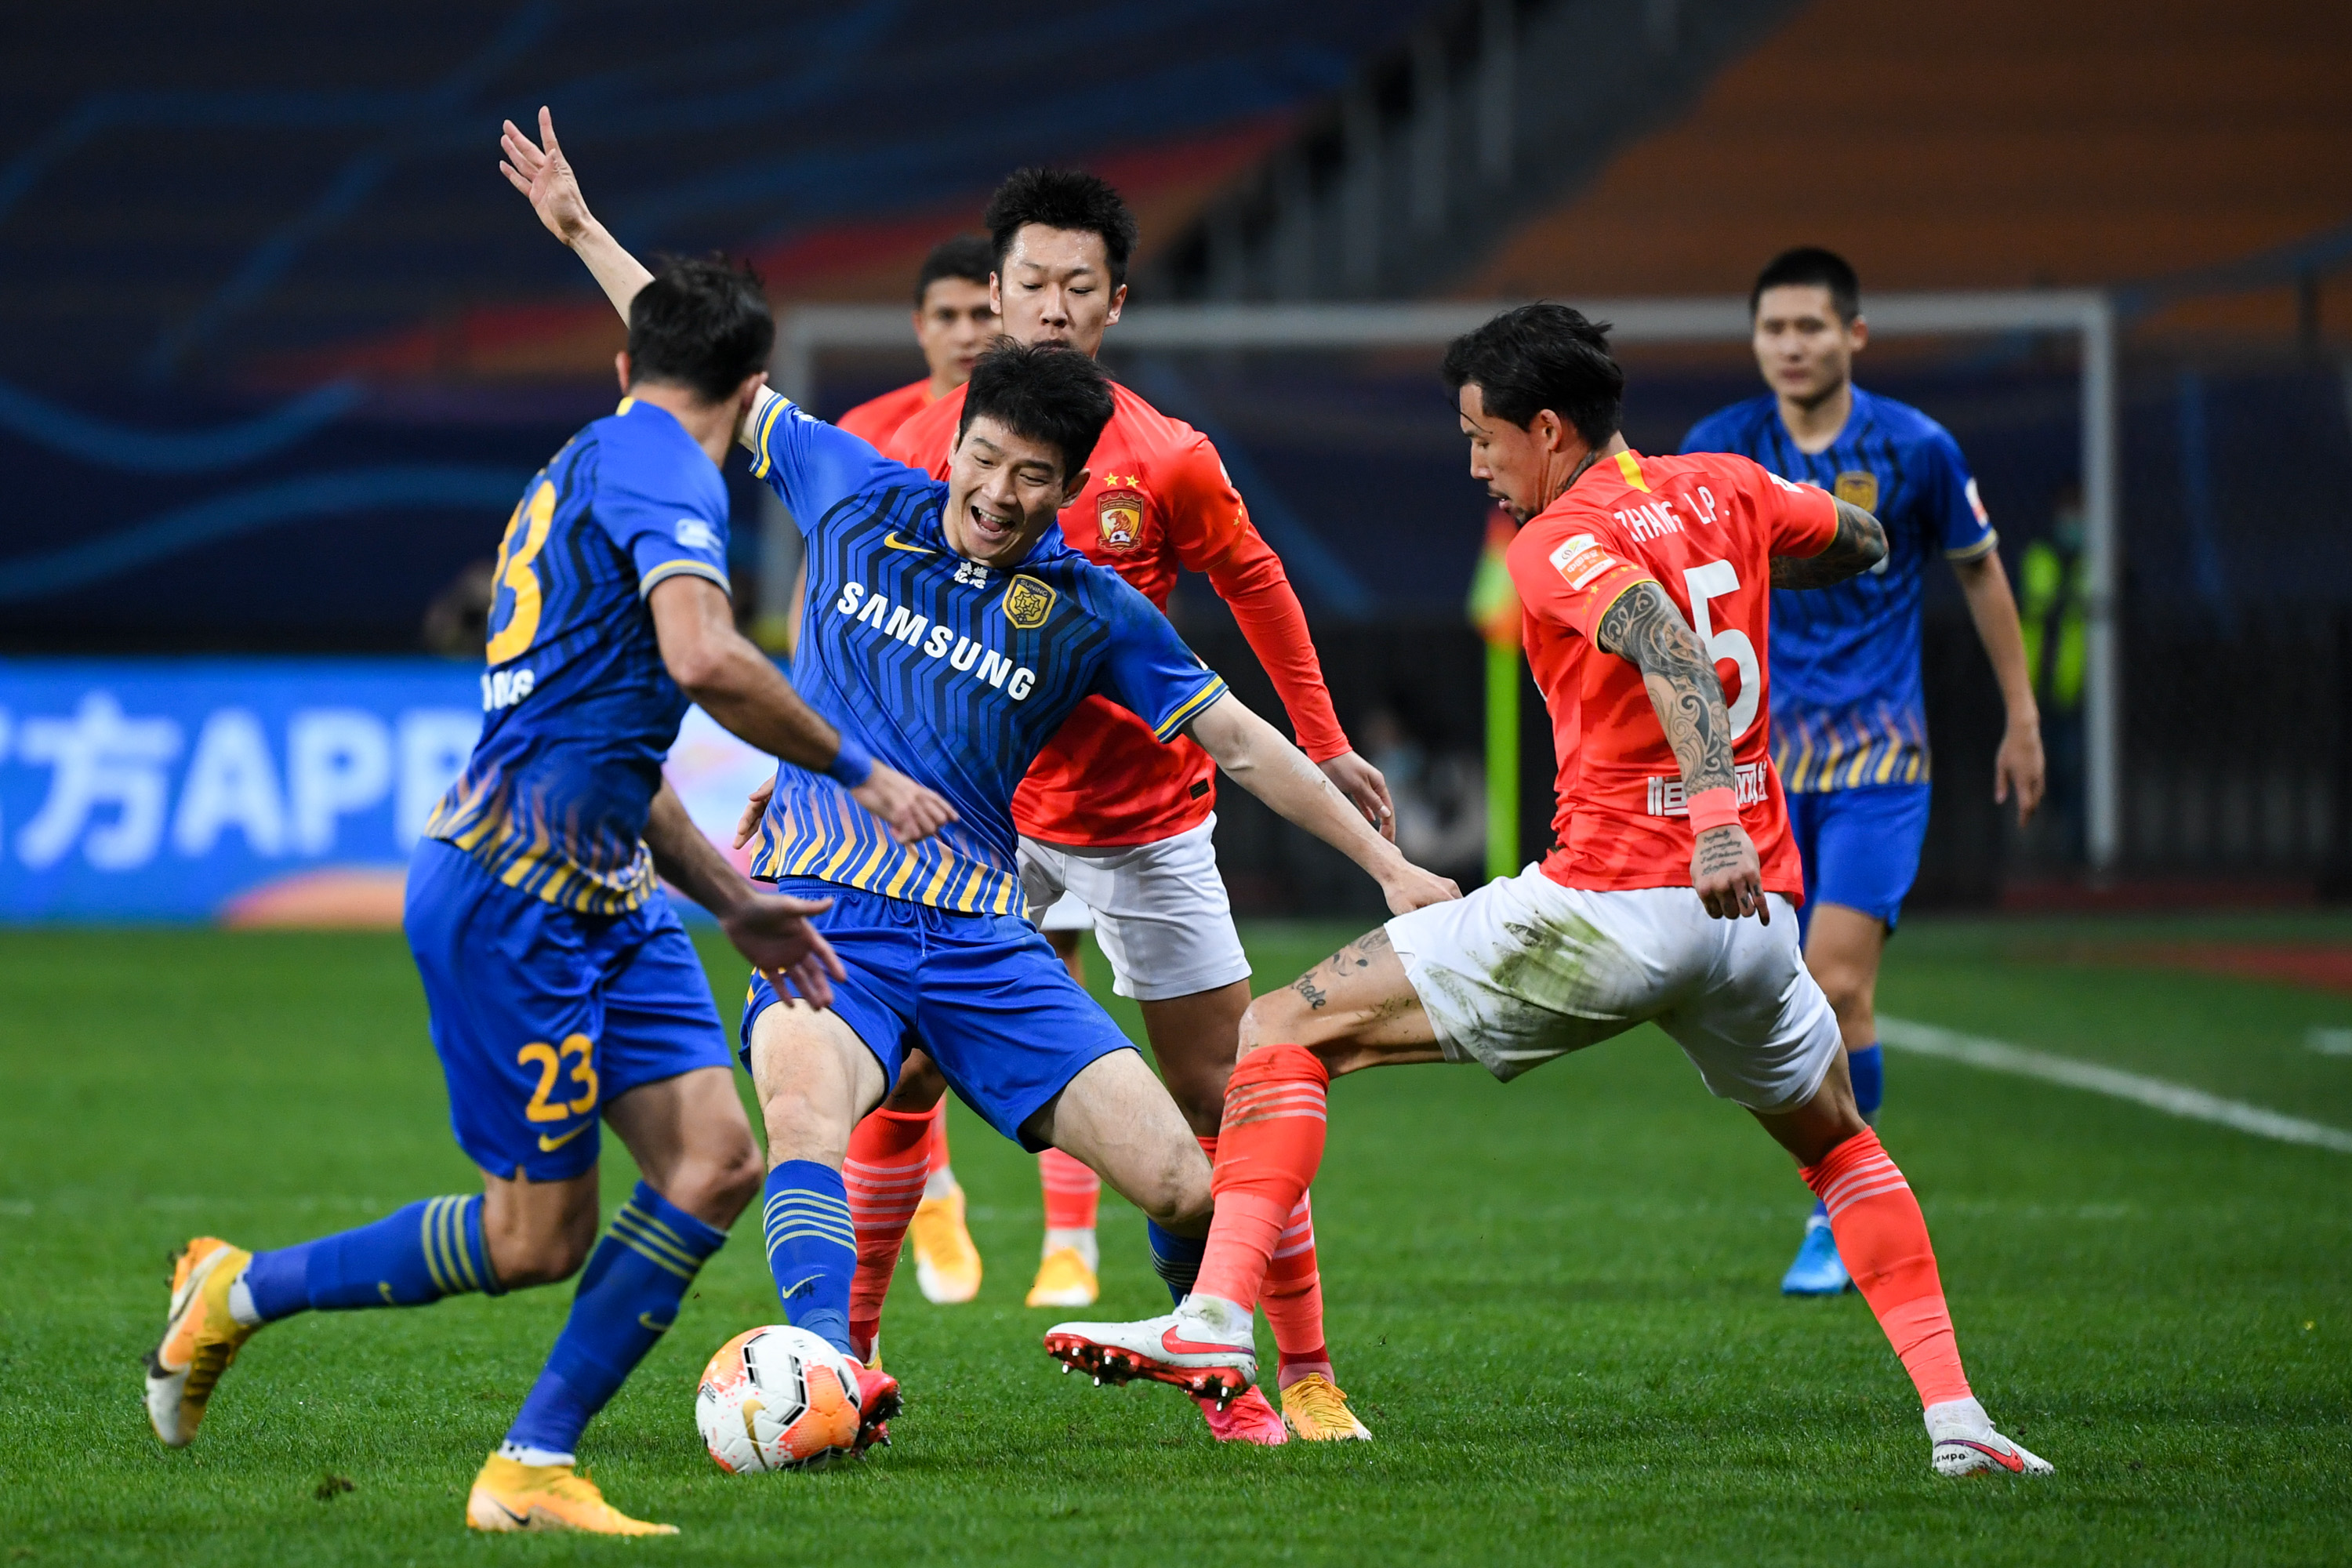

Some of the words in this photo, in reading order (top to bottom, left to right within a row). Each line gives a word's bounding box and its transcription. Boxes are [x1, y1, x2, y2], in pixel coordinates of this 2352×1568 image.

[1613, 500, 1685, 543] ZHANG
[1019, 579, 1048, 597] SUNING
[837, 581, 1036, 700] SAMSUNG
[1682, 559, 1761, 741] 5
[0, 691, 477, 871] 方APP
[517, 1033, 600, 1123] 23
